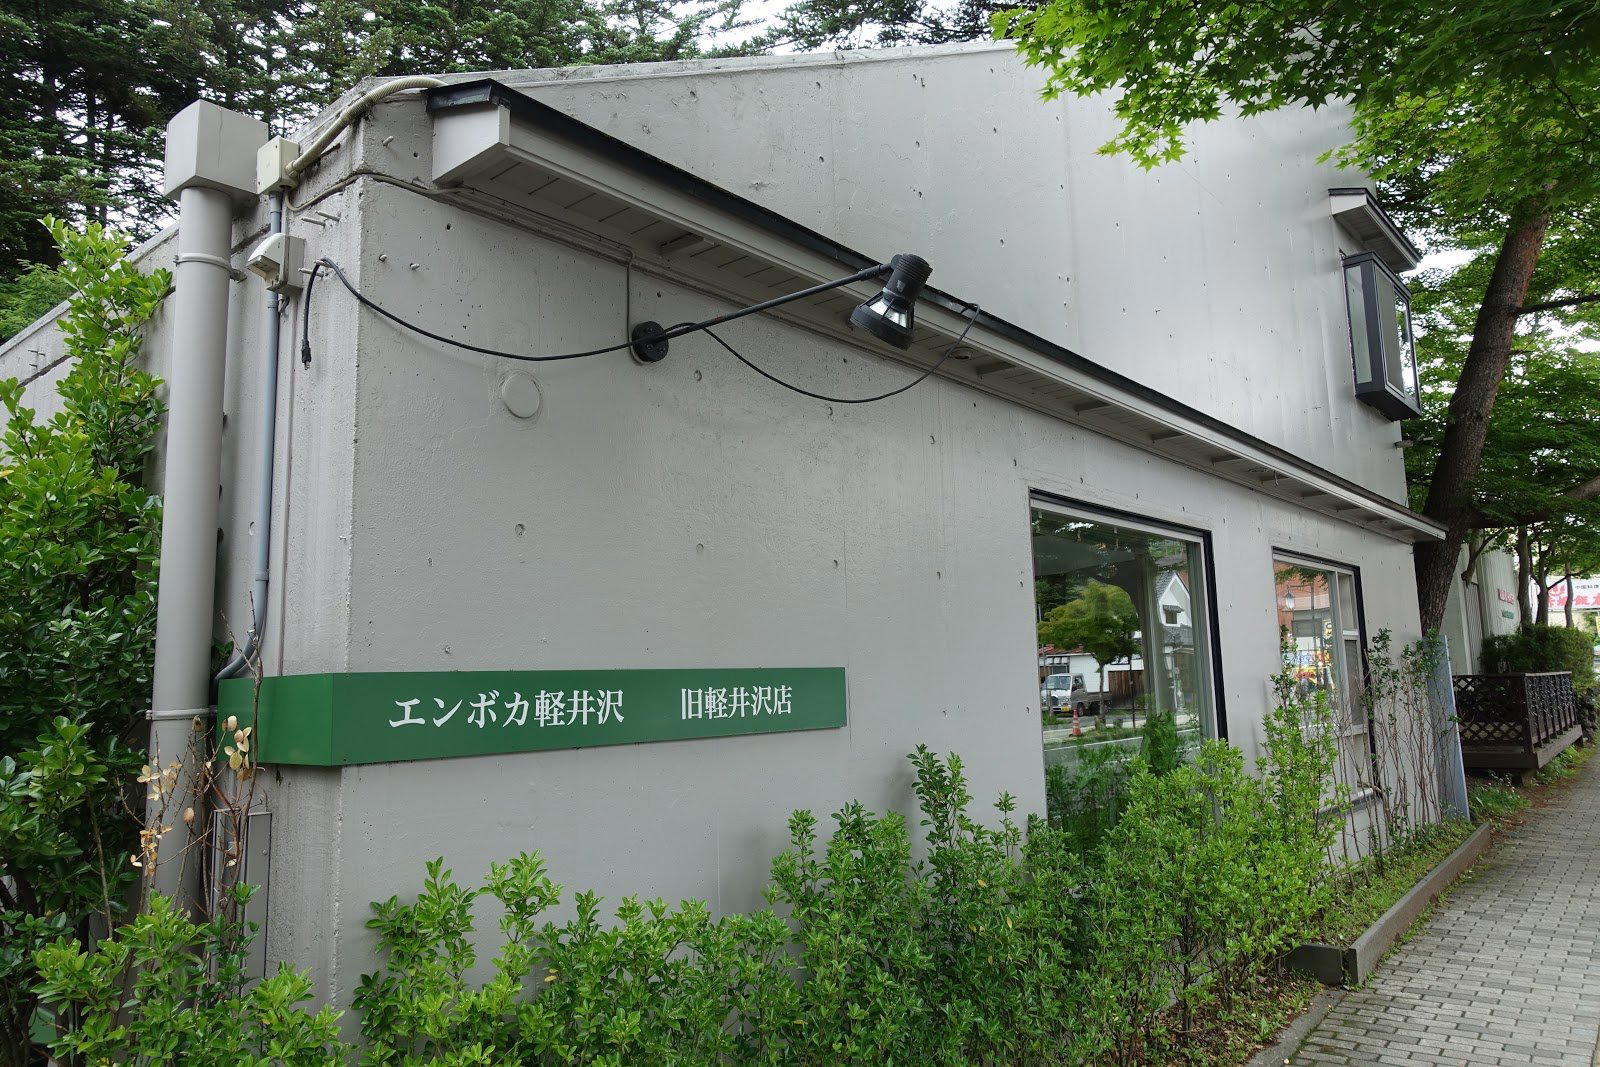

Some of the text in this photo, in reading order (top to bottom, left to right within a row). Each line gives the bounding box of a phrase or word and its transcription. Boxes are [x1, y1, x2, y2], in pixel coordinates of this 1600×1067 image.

[388, 685, 793, 729] エンボカ軽井沢 旧軽井沢店
